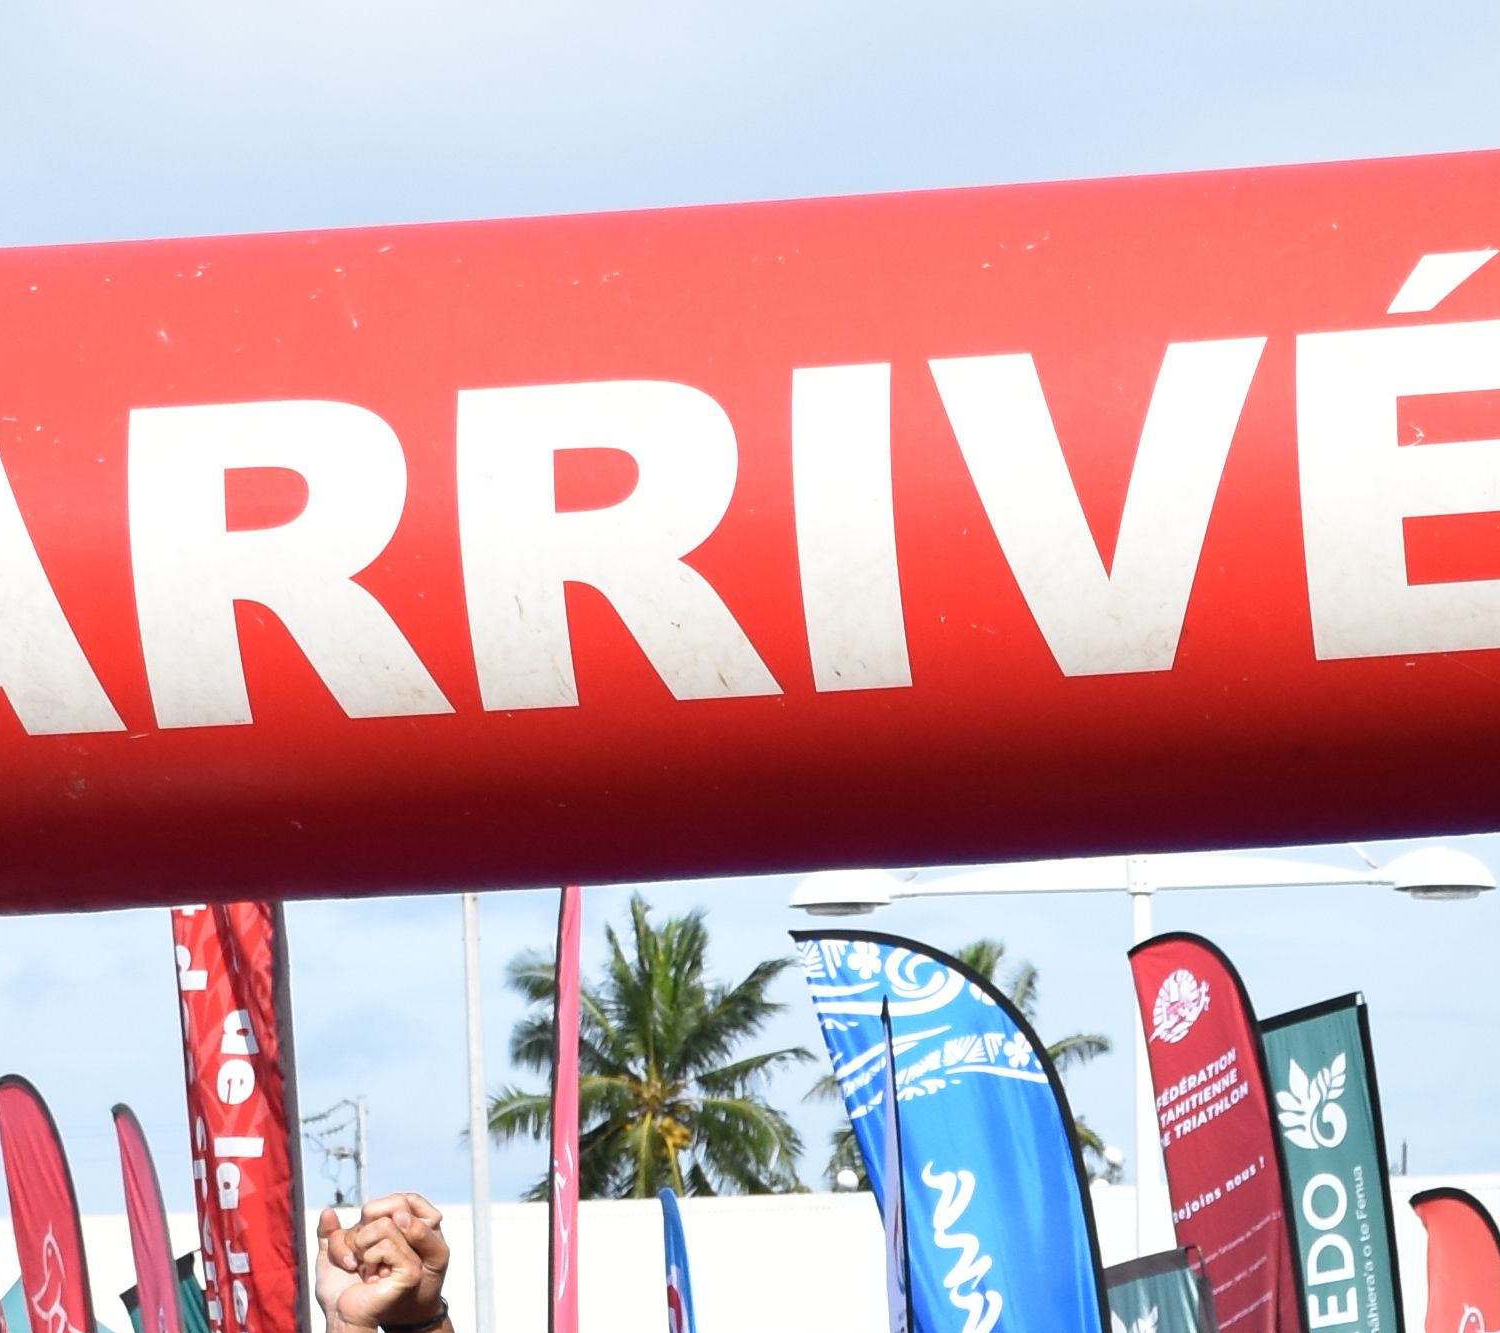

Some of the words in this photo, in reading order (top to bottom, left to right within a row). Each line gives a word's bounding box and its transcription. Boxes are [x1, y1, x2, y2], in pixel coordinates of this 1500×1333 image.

[1156, 1047, 1237, 1113] FÉDÉRATION
[1160, 1067, 1239, 1129] TAHITIENNE
[1174, 1081, 1249, 1140] TRIATHLON
[214, 1136, 264, 1210] la
[1226, 1163, 1257, 1193] nous
[1353, 1165, 1368, 1220] Fenua
